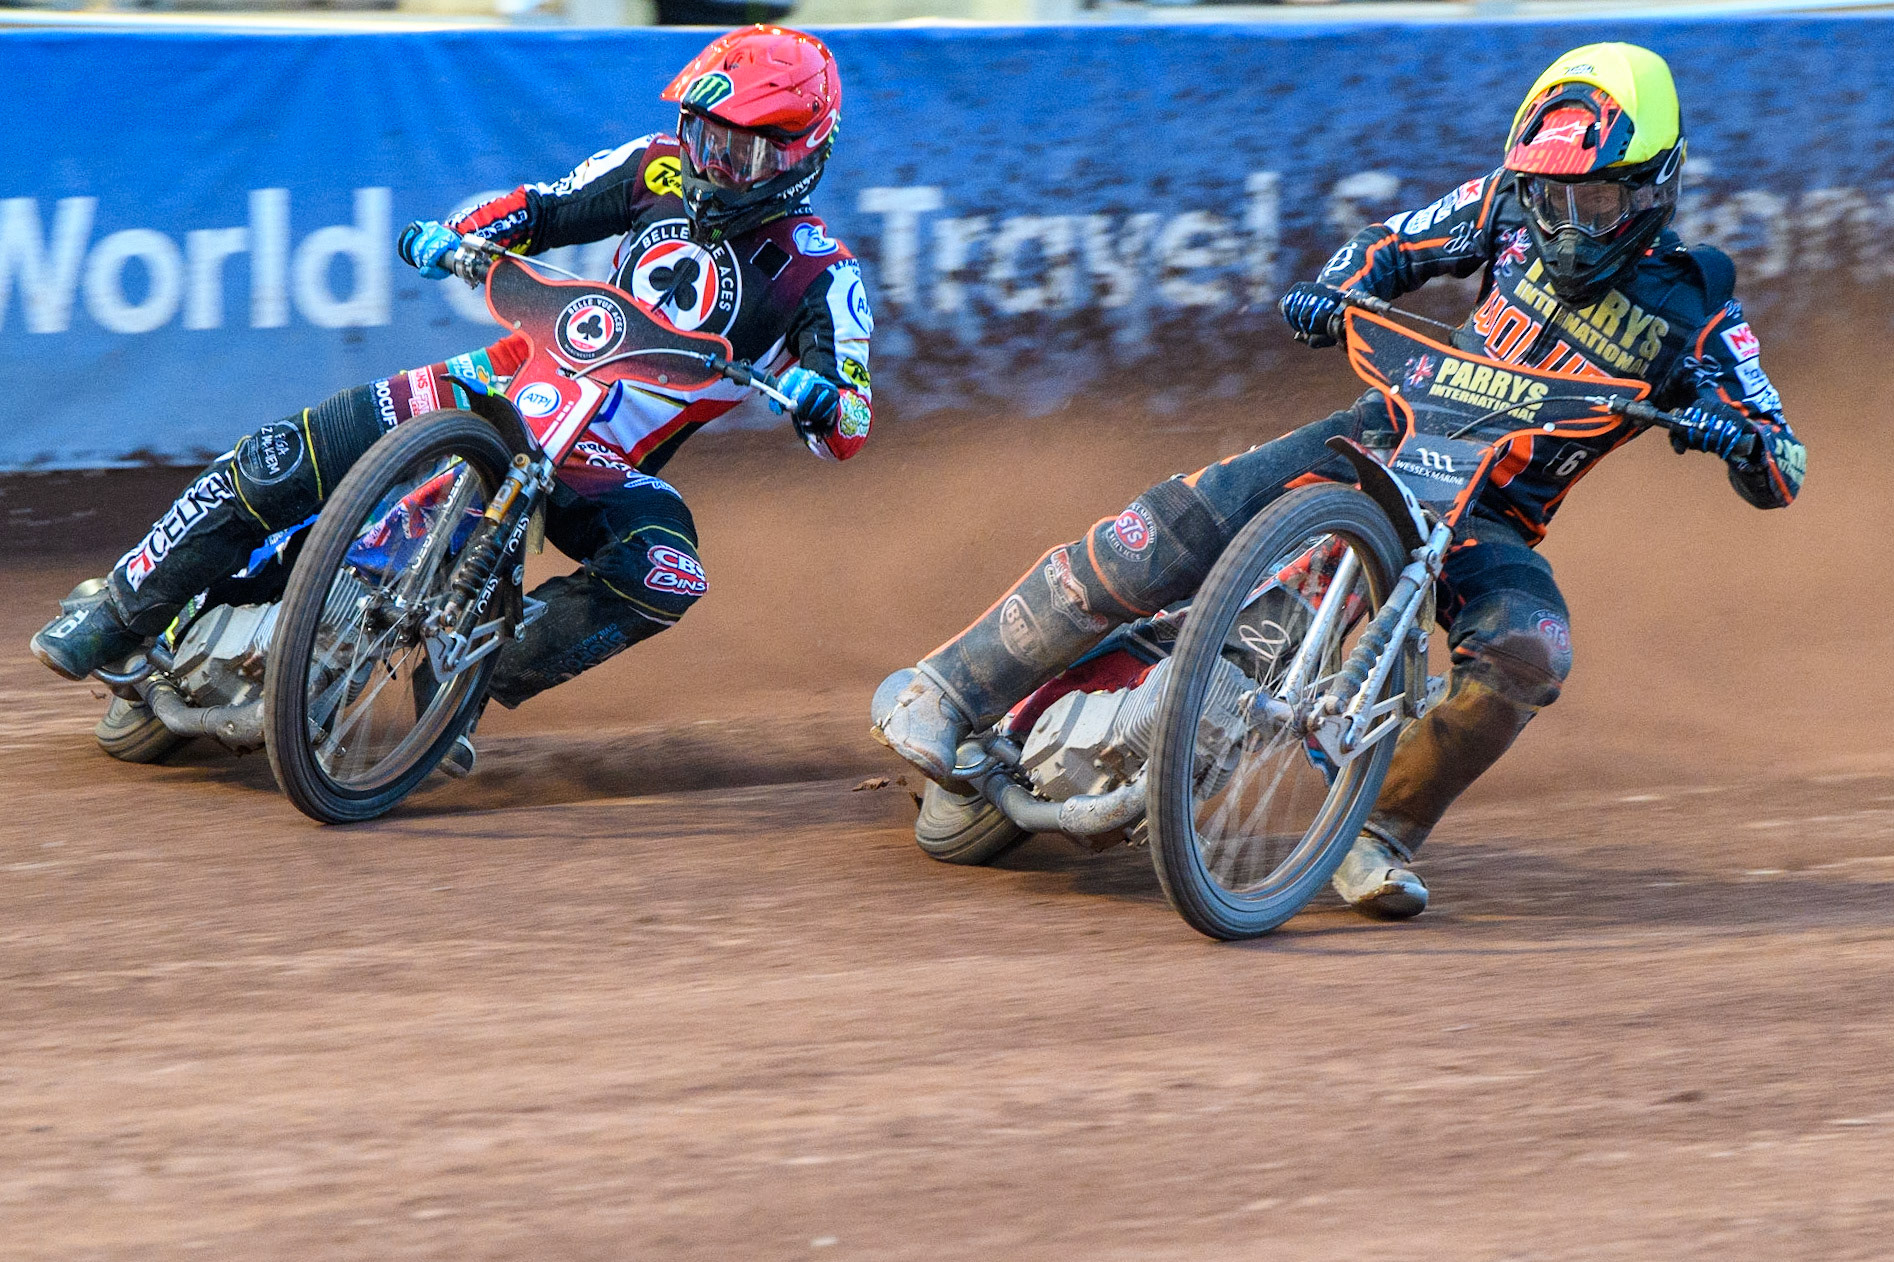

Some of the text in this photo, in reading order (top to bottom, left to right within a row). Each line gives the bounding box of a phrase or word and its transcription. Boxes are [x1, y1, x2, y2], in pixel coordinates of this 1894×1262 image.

[858, 172, 1282, 312] Travel
[0, 187, 393, 333] World
[642, 226, 690, 249] BELLE
[719, 266, 734, 311] ACES
[568, 298, 623, 332] BELLE VUE ACES
[523, 392, 552, 407] ATPI
[1434, 357, 1549, 411] PARRYS
[1396, 459, 1465, 486] WESSEX MARINE
[1555, 449, 1588, 476] 6
[508, 517, 530, 553] GEO
[1117, 515, 1145, 544] STS
[650, 571, 706, 591] BINS
[653, 549, 706, 582] CBS
[477, 578, 499, 614] GEO
